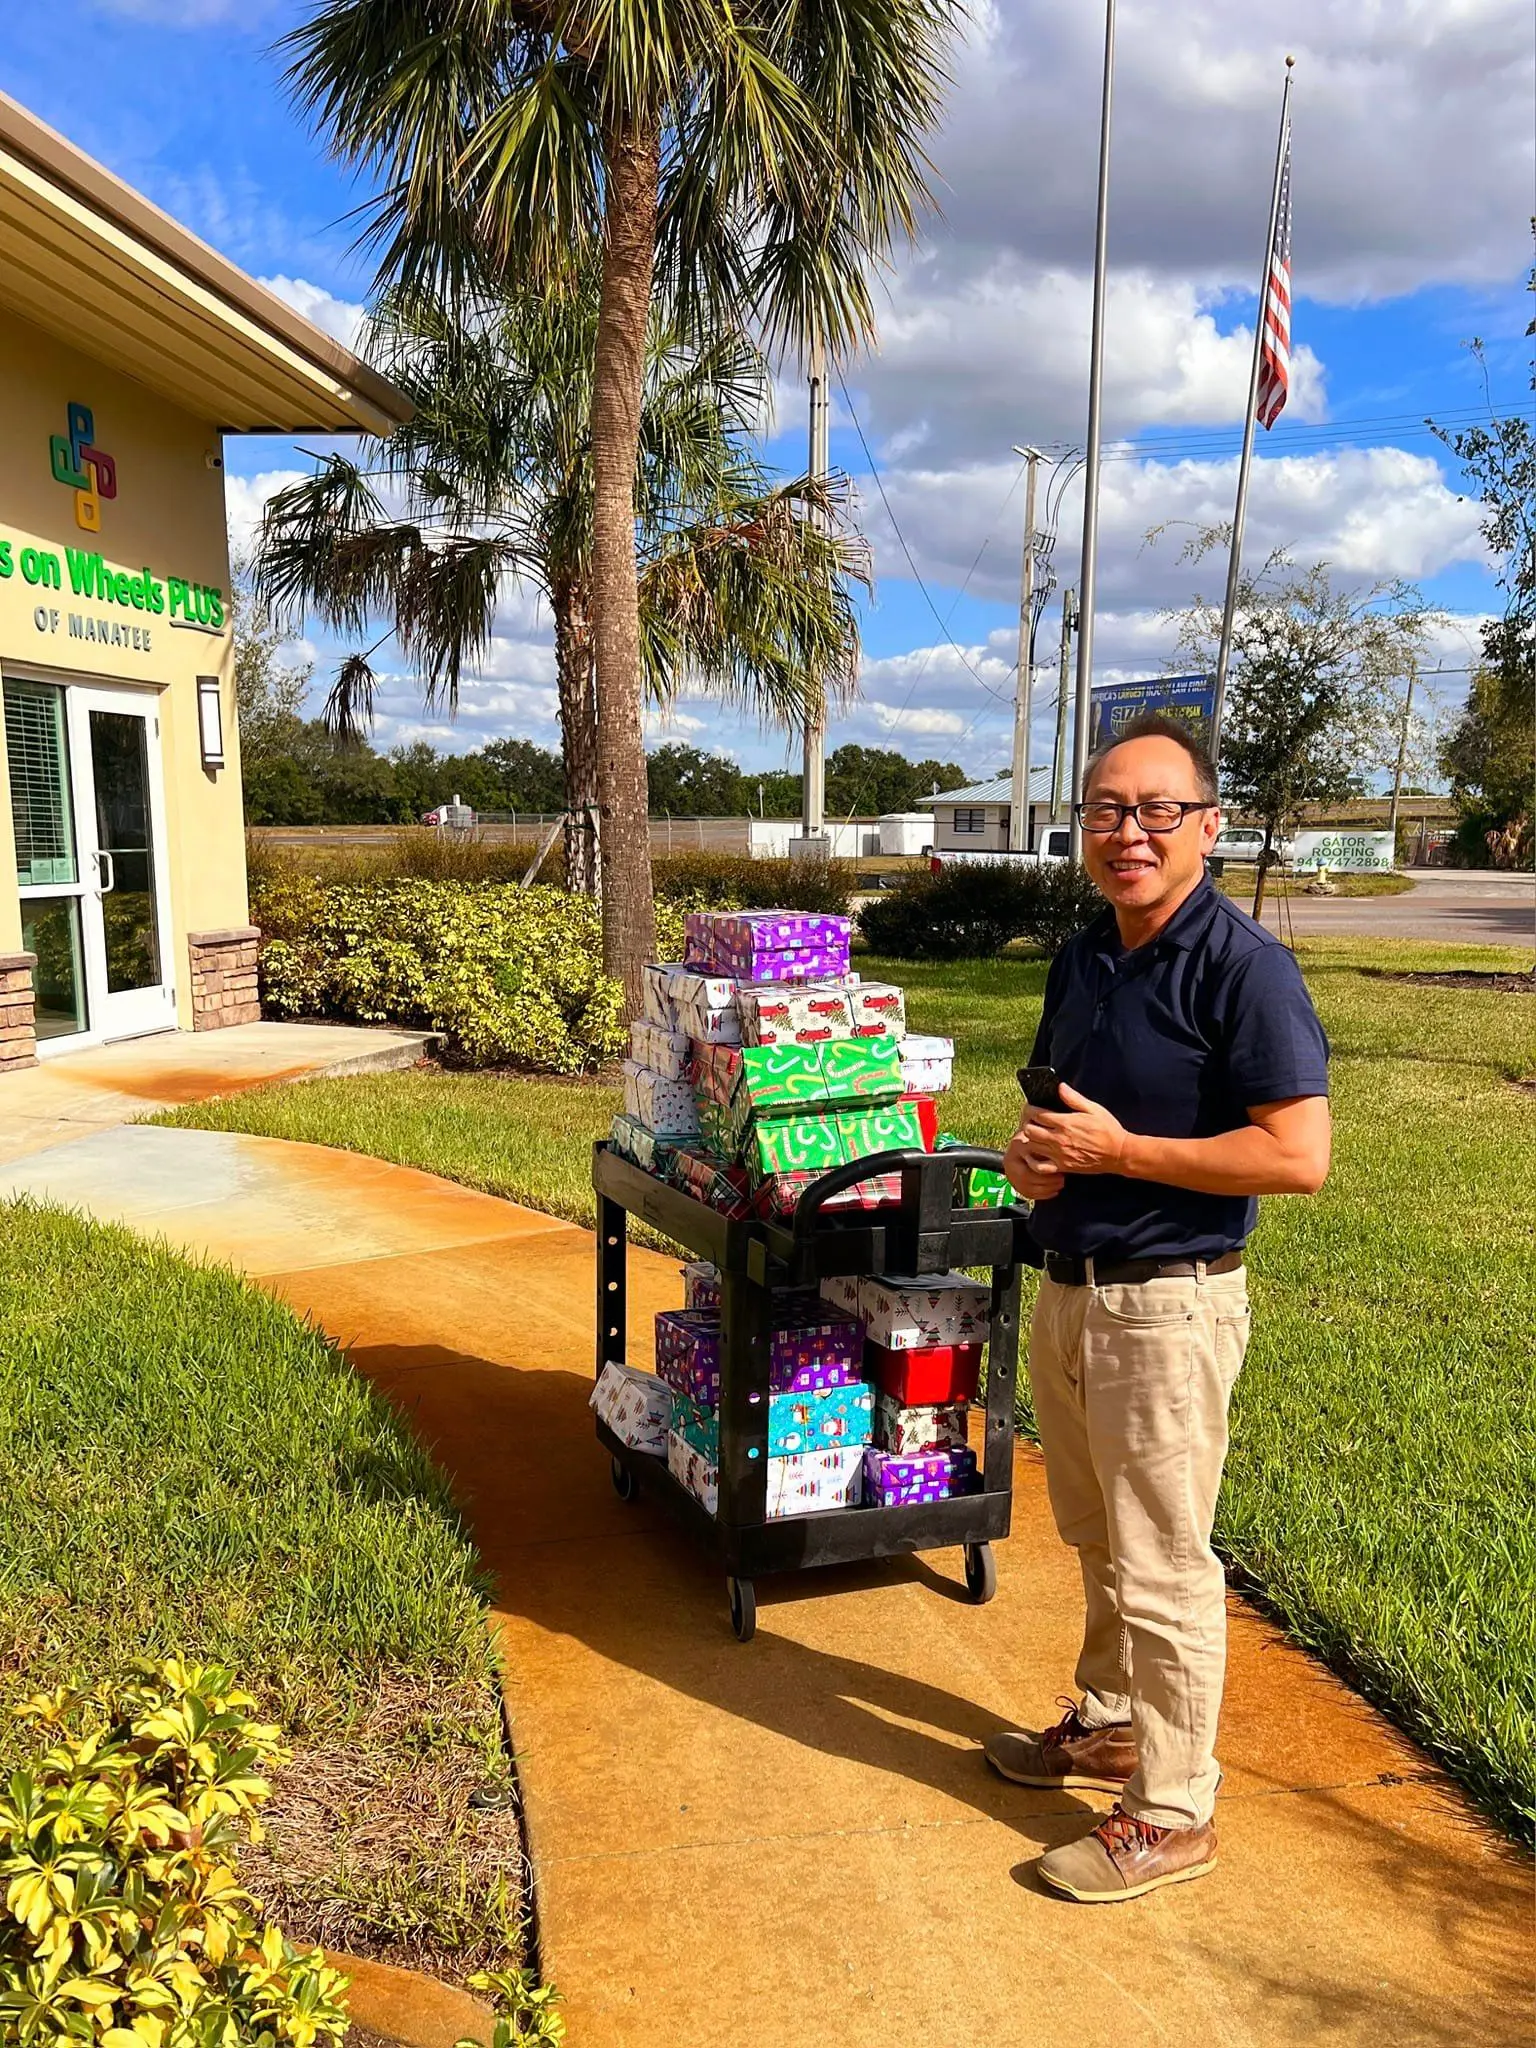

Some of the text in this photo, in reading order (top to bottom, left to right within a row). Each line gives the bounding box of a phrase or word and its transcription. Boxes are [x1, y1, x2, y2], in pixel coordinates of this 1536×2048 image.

[20, 547, 61, 590] on
[64, 546, 165, 616] Wheels
[167, 576, 224, 629] PLUS
[34, 606, 152, 653] OF MANATEE
[1312, 847, 1375, 857] ROOFING
[1322, 837, 1365, 847] GATOR
